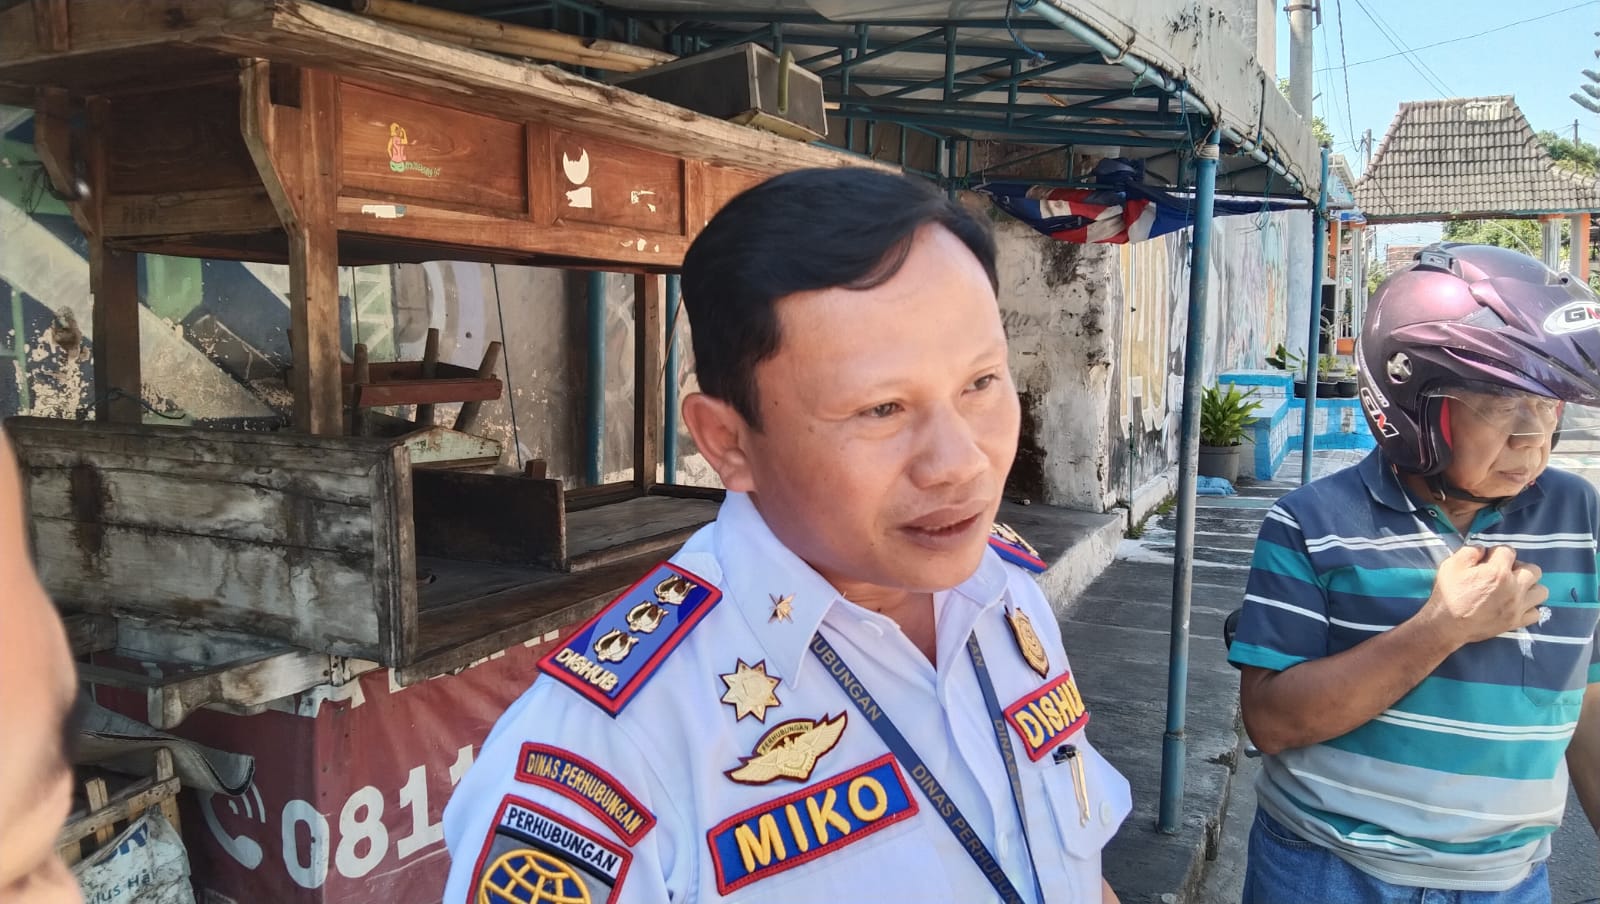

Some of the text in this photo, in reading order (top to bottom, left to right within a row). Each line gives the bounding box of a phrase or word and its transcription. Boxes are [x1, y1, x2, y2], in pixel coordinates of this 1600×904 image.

[555, 647, 619, 691] DISHUB
[761, 724, 809, 751] PERHUBUNGAN
[526, 753, 644, 834] DINAS PERHUBUNGAN
[911, 764, 955, 817] DINAS
[507, 807, 618, 872] PERHUBUNGAN
[735, 776, 888, 873] MIKO
